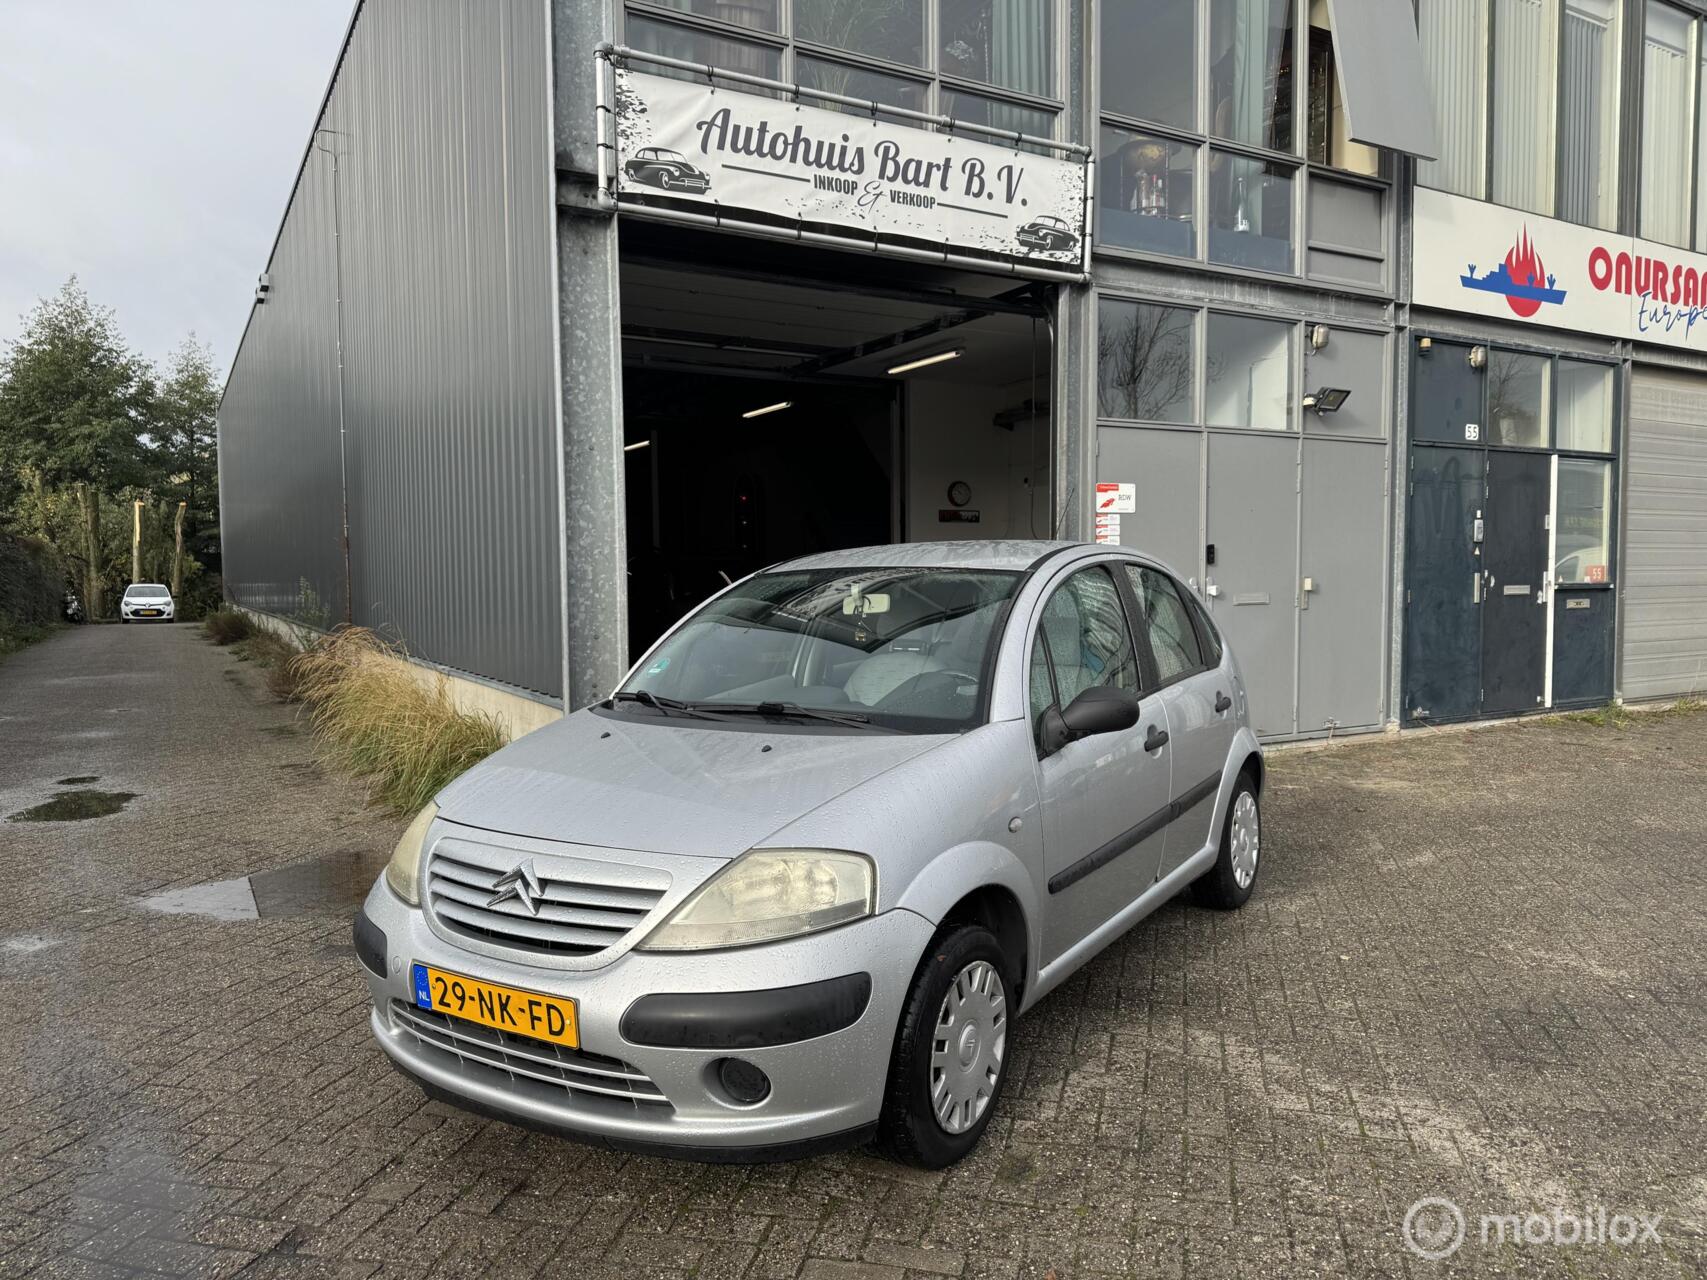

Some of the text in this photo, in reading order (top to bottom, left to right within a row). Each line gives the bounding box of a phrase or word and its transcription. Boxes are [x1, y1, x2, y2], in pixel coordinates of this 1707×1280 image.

[696, 108, 1029, 207] Autohuis Bart B.V.
[813, 173, 858, 197] INKOOP
[889, 188, 936, 210] VERKOOP
[1467, 426, 1478, 438] 55
[1592, 567, 1602, 579] 55
[418, 976, 566, 1037] NL 29-NK-FD
